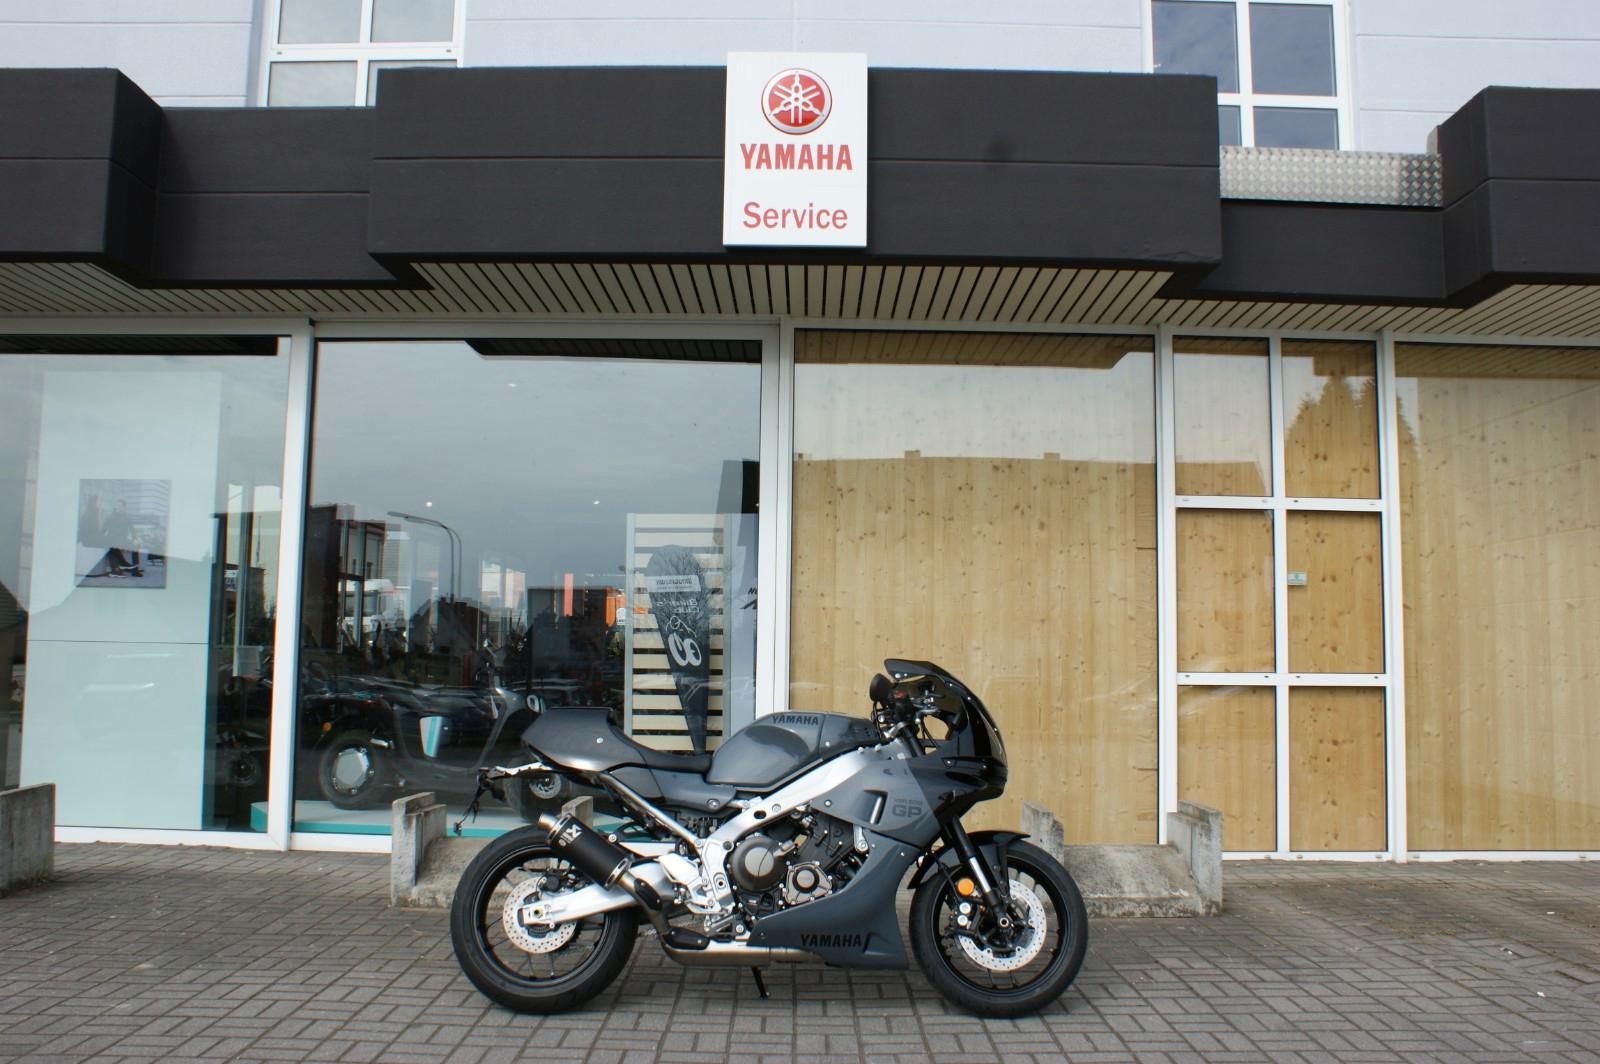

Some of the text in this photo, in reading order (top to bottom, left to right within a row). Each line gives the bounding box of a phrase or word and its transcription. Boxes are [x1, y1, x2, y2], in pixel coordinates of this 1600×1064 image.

[740, 143, 853, 170] YAMAHA
[743, 202, 848, 229] Service
[772, 715, 819, 726] YAMAHA
[892, 804, 922, 818] GP
[800, 934, 862, 948] YAMAHA
